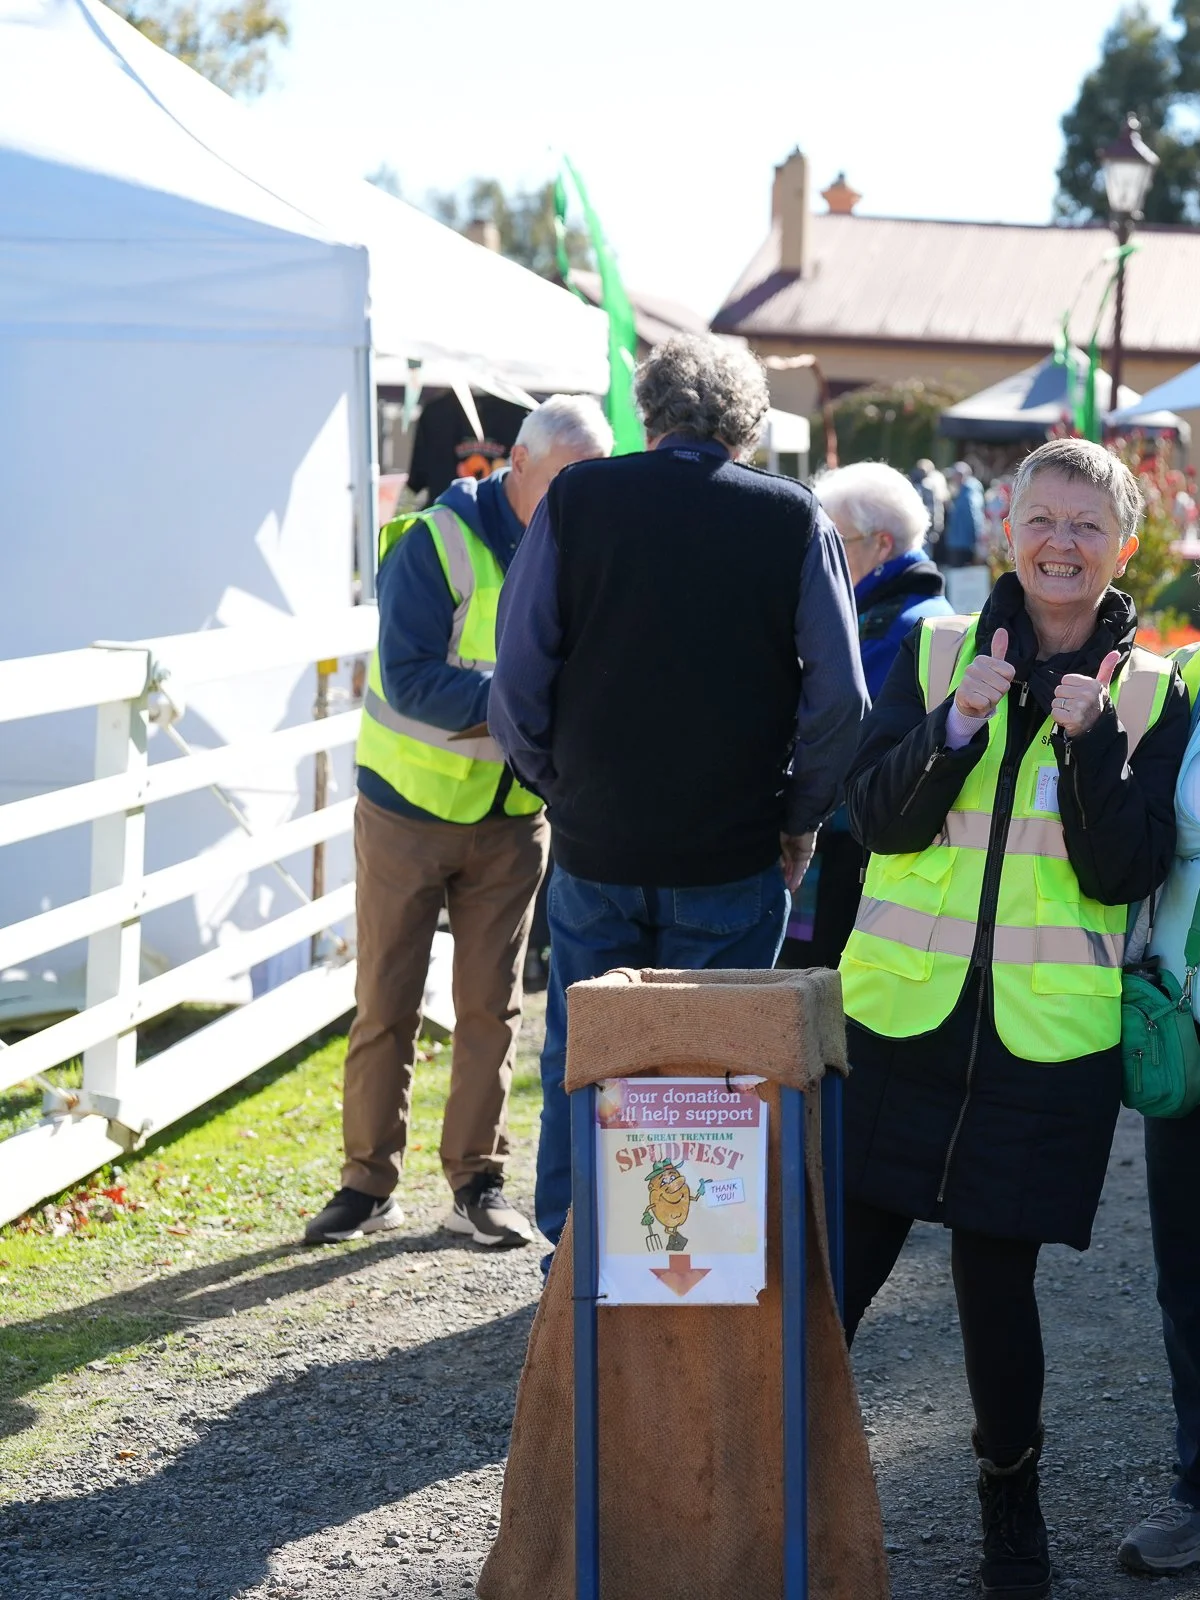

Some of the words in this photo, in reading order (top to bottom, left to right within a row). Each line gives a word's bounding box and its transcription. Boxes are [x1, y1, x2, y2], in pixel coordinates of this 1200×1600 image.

[625, 1090, 658, 1104] our
[662, 1088, 741, 1104] donation
[642, 1105, 680, 1126] help
[685, 1107, 753, 1126] support
[647, 1133, 677, 1142] GREAT
[680, 1132, 733, 1141] TRENTHAM
[615, 1141, 744, 1173] SPUDFEST
[711, 1183, 738, 1194] THANK
[715, 1192, 735, 1202] YOU!
